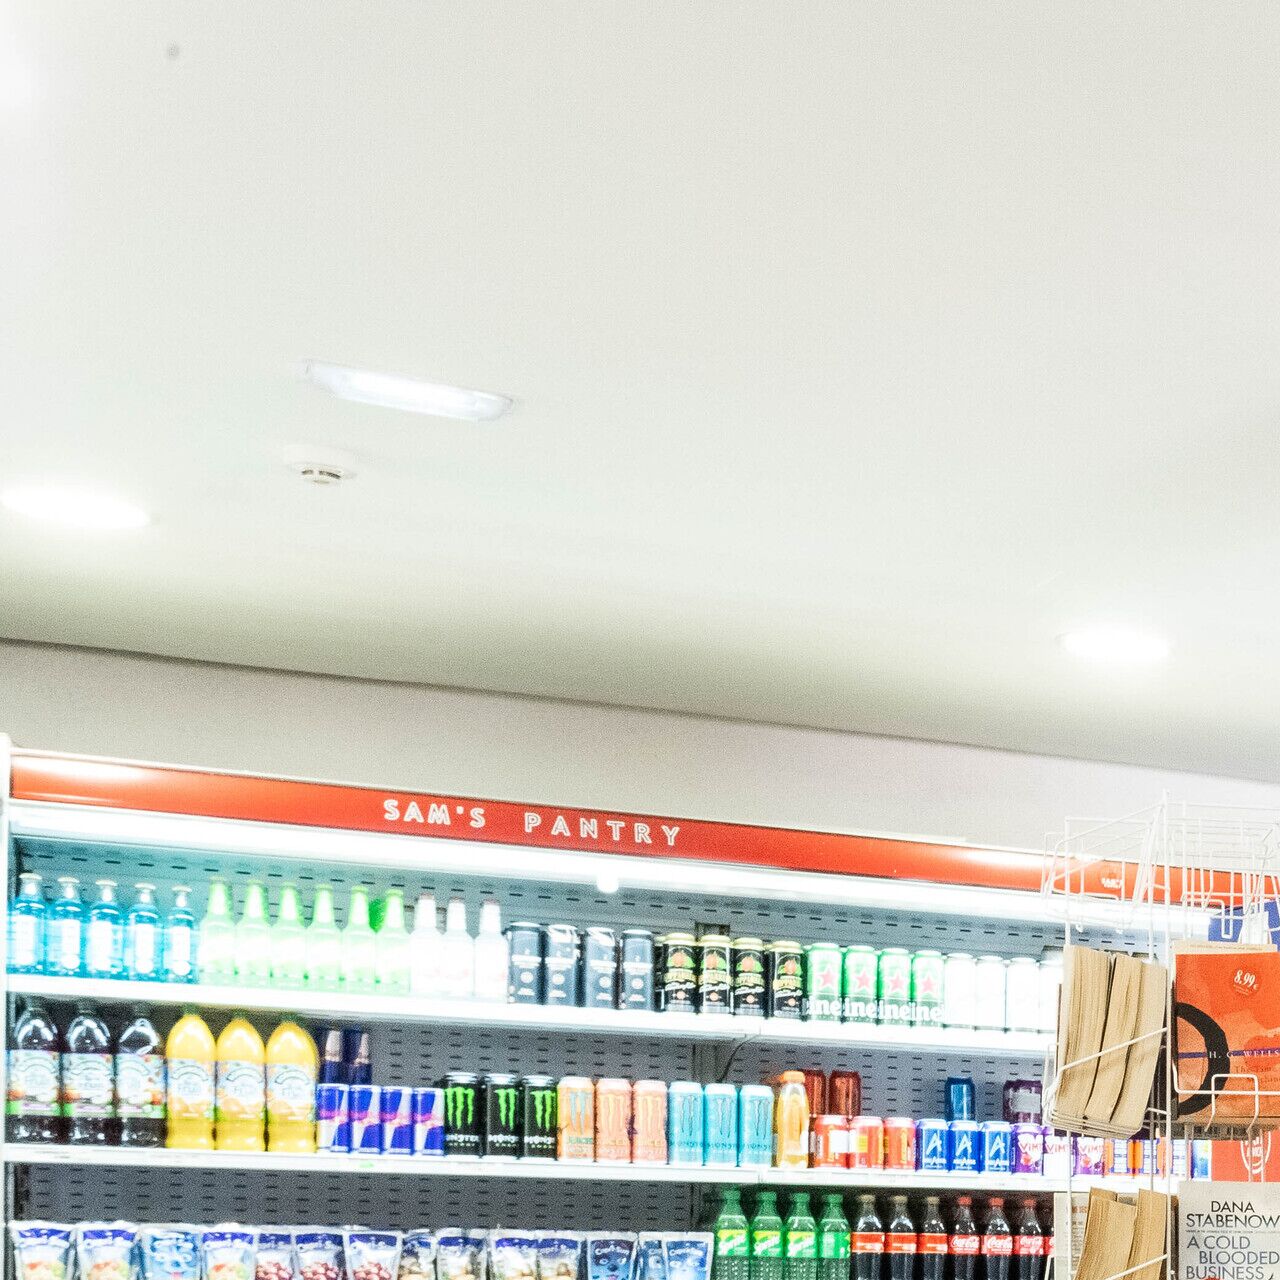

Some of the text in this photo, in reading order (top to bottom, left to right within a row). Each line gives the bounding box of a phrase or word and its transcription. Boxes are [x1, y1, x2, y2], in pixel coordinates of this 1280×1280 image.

[384, 799, 679, 846] SAM'S PANTRY
[1211, 1201, 1254, 1212] DANA
[1186, 1213, 1280, 1228] STABENOW
[1187, 1236, 1250, 1250] A COLD
[1215, 1251, 1280, 1265] BLOODED
[1185, 1266, 1265, 1280] BUSINESS
